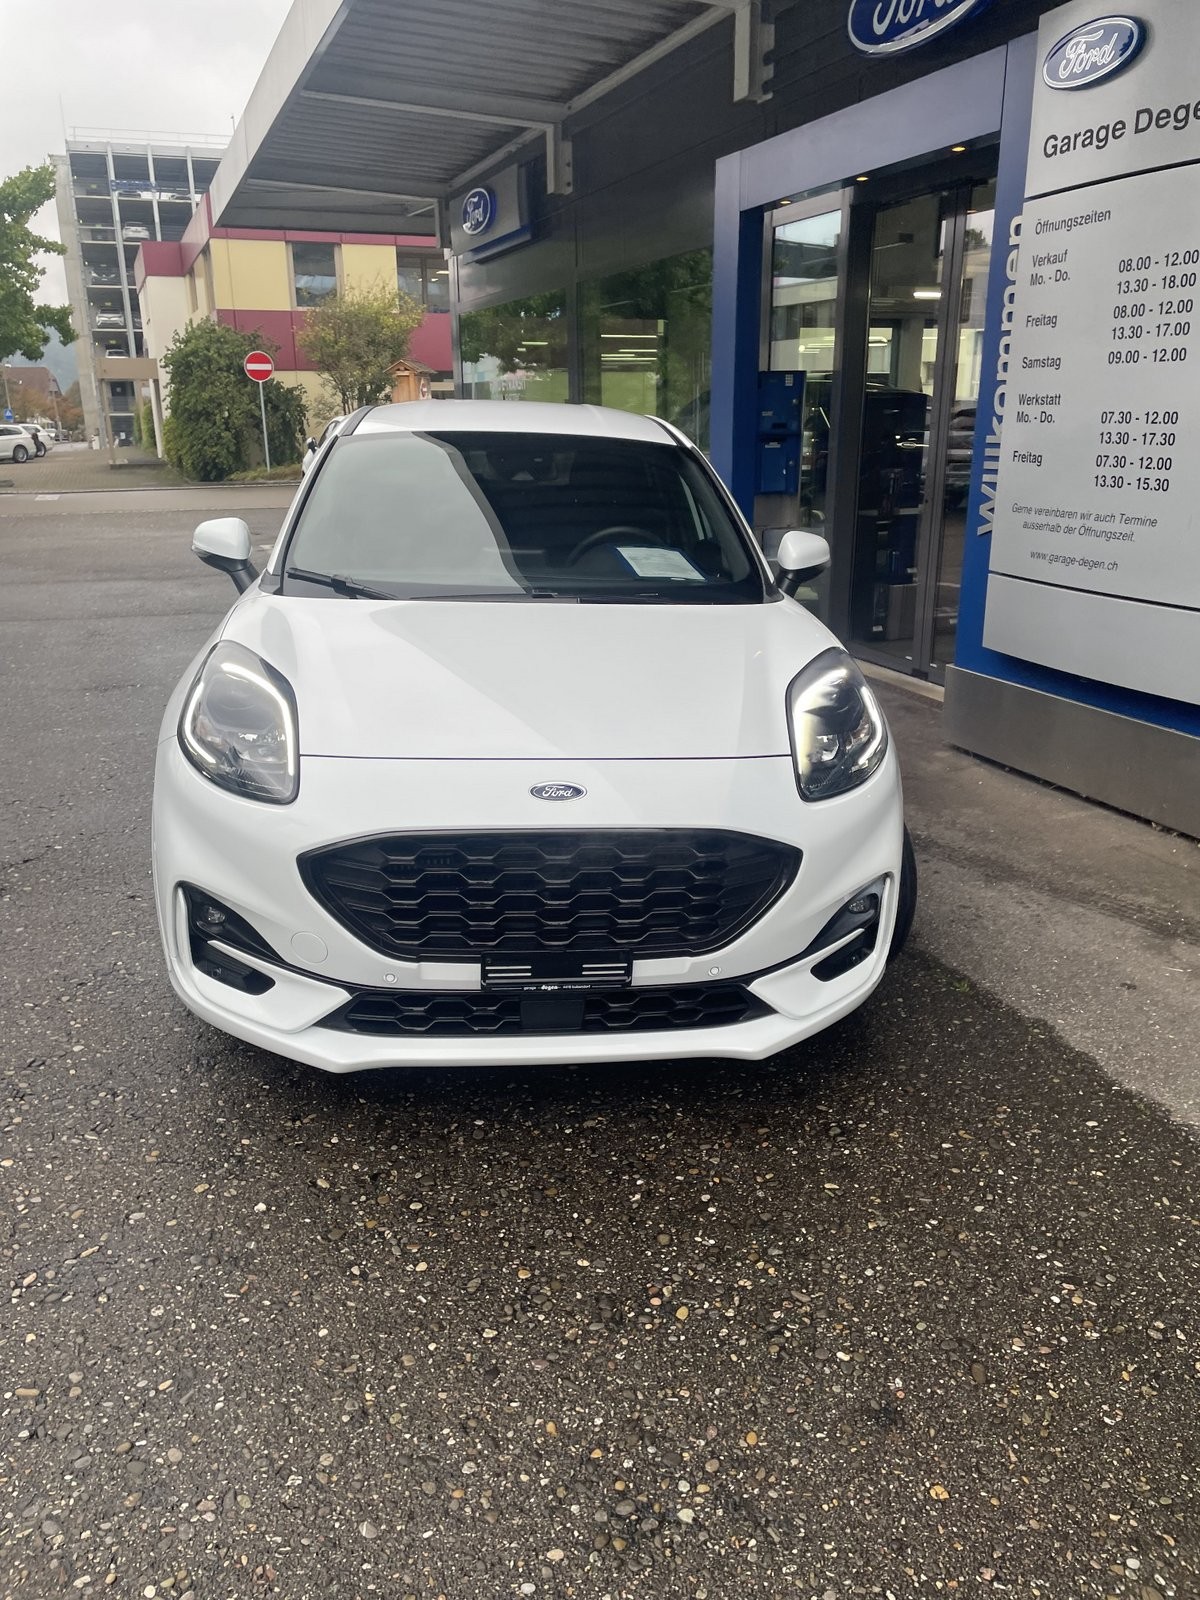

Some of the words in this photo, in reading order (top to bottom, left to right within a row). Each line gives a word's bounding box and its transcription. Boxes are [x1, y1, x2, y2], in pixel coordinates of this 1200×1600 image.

[1058, 29, 1118, 79] Ford
[1043, 119, 1126, 158] Garage
[465, 195, 484, 229] Ford
[1035, 209, 1111, 235] Öffnungszeiten
[1032, 249, 1068, 268] Verkauf
[1118, 256, 1151, 273] 08.00
[1164, 249, 1200, 267] 12.00
[1030, 273, 1046, 286] Mo.
[1054, 269, 1071, 283] Do.
[1117, 278, 1148, 294] 13.30
[1161, 272, 1197, 290] 18.00
[1113, 303, 1146, 319] 08.00
[1158, 299, 1194, 316] 12.00
[1026, 314, 1058, 328] Freitag
[1112, 325, 1143, 340] 13.30
[1155, 321, 1191, 338] 17.00
[1022, 356, 1061, 370] Samstag
[1108, 351, 1140, 365] 09.00
[1152, 347, 1187, 363] 12.00
[1018, 393, 1061, 406] Werkstatt
[1016, 411, 1032, 424] Mo.
[1040, 411, 1056, 424] Do.
[1101, 411, 1132, 424] 07.30
[1144, 411, 1179, 425] 12.00
[1099, 431, 1130, 445] 13.30
[1142, 432, 1176, 446] 17.30
[1012, 450, 1043, 467] Freitag
[1095, 454, 1127, 469] 07.30
[1139, 456, 1173, 471] 12.00
[1094, 475, 1124, 489] 13.30
[1136, 477, 1170, 492] 15.30
[1012, 503, 1033, 515] Gerne
[1034, 506, 1078, 520] vereinbaren
[1079, 511, 1092, 521] wir
[1093, 512, 1116, 524] auch
[1118, 513, 1158, 528] Termine
[1022, 520, 1062, 533] ausserhalb
[1062, 524, 1077, 535] der
[1078, 523, 1136, 542] Öffnungszeit.
[1030, 550, 1118, 572] www.garage-degen.ch
[542, 785, 574, 797] Ford
